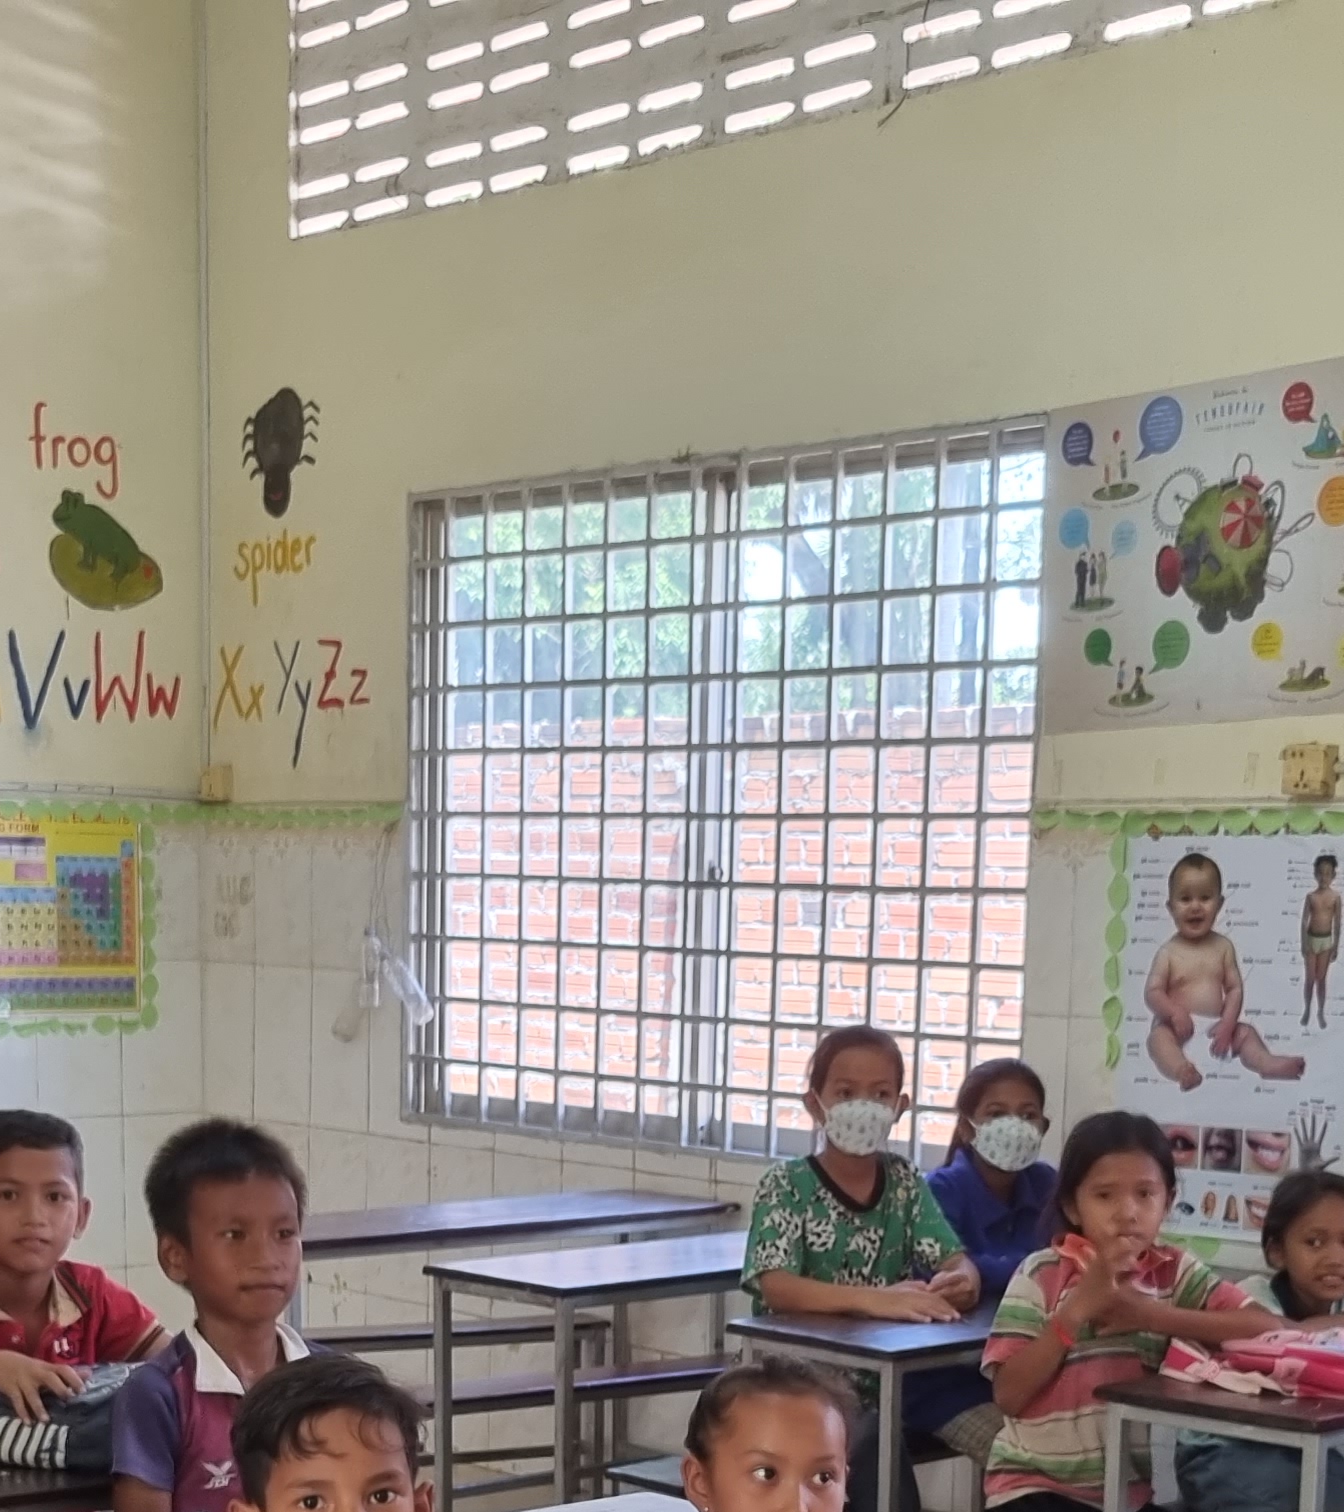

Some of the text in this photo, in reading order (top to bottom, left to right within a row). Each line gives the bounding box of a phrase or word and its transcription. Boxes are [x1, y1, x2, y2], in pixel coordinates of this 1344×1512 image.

[28, 401, 120, 500] frog
[233, 529, 317, 606] spider
[8, 823, 40, 834] FORM
